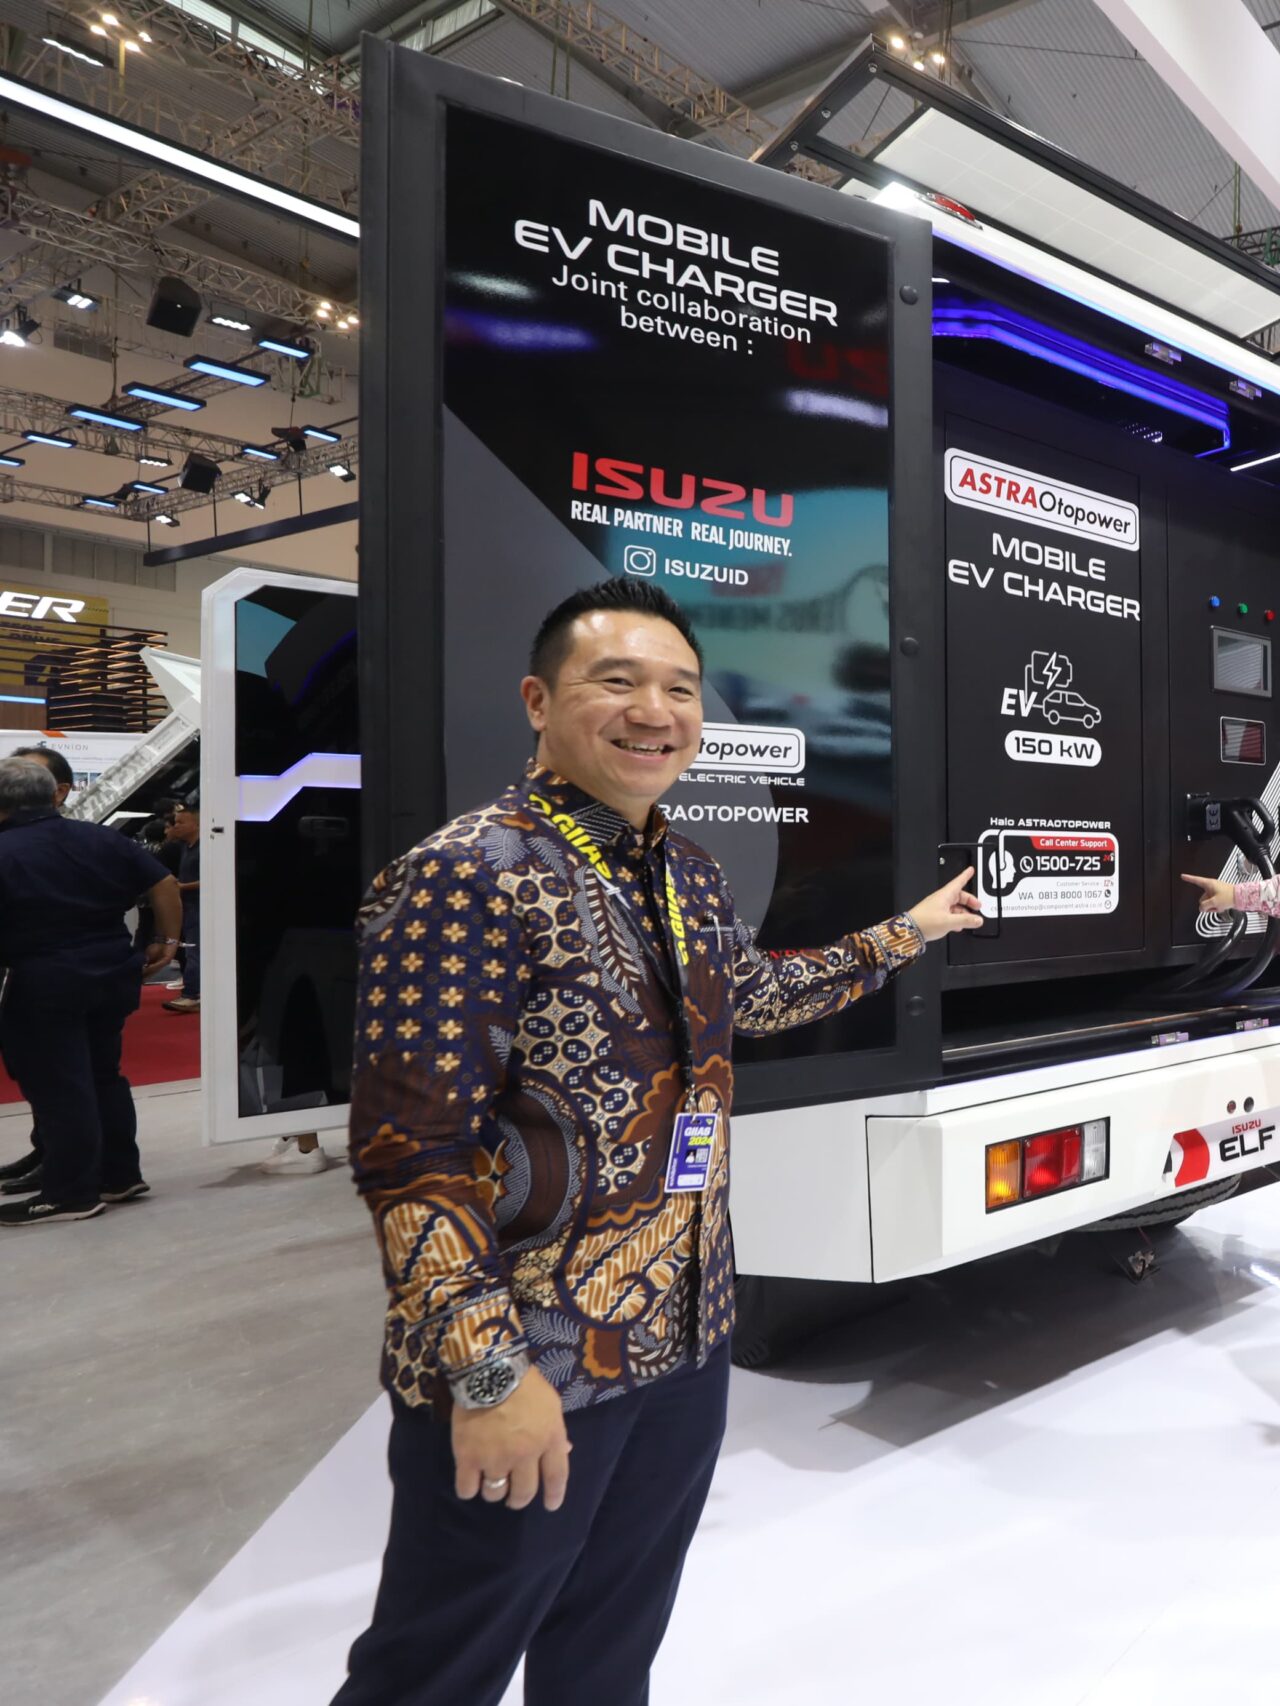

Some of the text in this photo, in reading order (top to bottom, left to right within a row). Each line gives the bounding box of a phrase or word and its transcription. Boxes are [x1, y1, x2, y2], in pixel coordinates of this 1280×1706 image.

[588, 199, 779, 276] MOBILE
[514, 219, 838, 327] EV CHARGER
[552, 265, 811, 343] Joint collaboration
[620, 305, 737, 351] between
[571, 451, 794, 528] ISUZU
[959, 468, 1131, 534] ASTRAOtopower
[571, 500, 793, 557] REAL PARTNER REAL JOURNEY.
[665, 558, 749, 586] ISUZUID
[992, 533, 1106, 581] MOBILE
[948, 559, 1140, 621] EV CHARGER
[1001, 687, 1038, 717] EV
[1014, 736, 1095, 760] 150 kW
[678, 773, 805, 786] ELECTRIC VEHICLE
[990, 817, 1111, 829] Halo ASTRAOTOPOWER
[1039, 838, 1108, 848] Call Center Support
[1035, 856, 1101, 871] 1500-725
[1018, 890, 1103, 900] WA 0813 8000 1067
[1219, 1125, 1276, 1162] ELF
[1232, 1119, 1262, 1135] ISUZU
